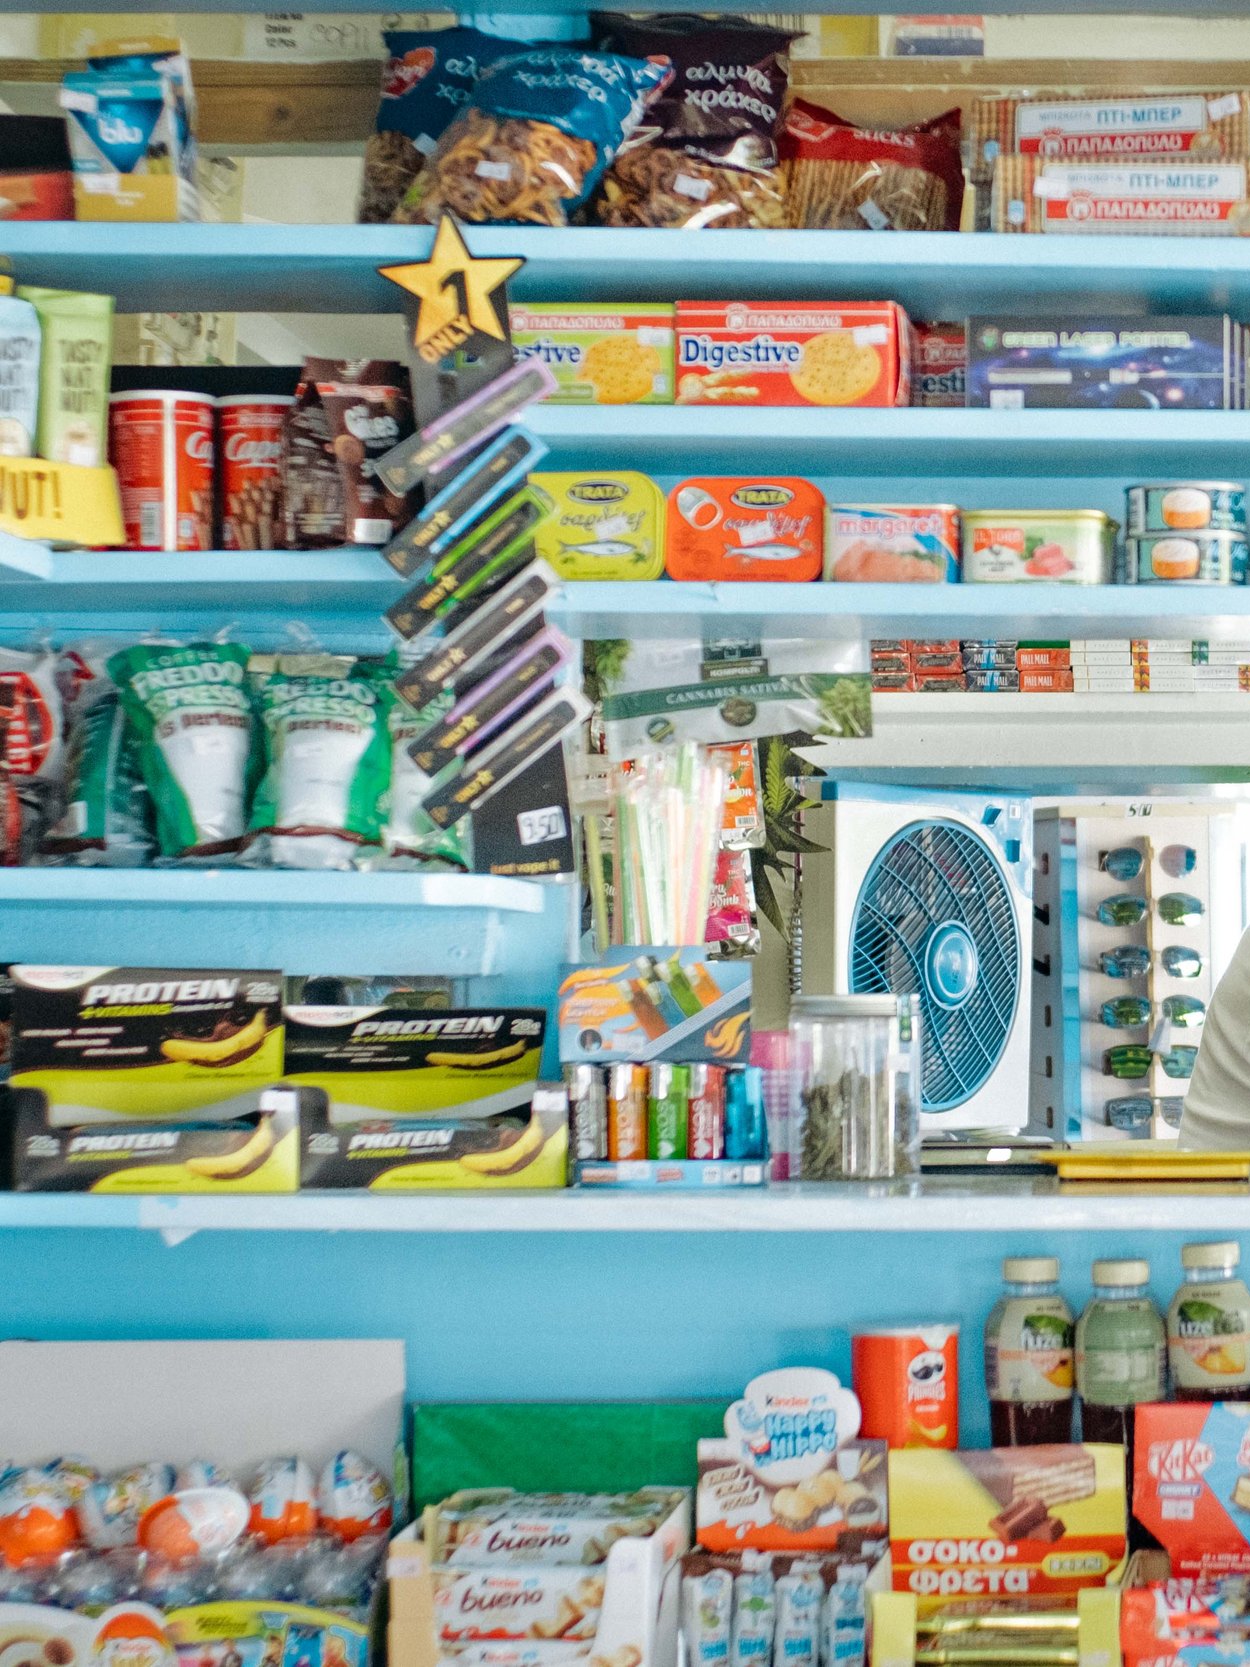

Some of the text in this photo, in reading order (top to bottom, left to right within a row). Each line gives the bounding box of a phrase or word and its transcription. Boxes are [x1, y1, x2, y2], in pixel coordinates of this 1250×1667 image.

[99, 116, 142, 145] blu
[419, 315, 474, 364] ONLY
[513, 345, 582, 364] estive
[681, 339, 801, 368] Digestive
[0, 467, 63, 520] UT!
[572, 484, 624, 502] TRATA
[738, 488, 788, 506] TRATA
[974, 654, 1005, 664] PALL MALL
[1021, 654, 1050, 665] PALL MALL
[129, 661, 244, 700] FREDDO
[977, 675, 1008, 686] PALL MALL
[1024, 675, 1053, 686] PALL MALL
[665, 680, 789, 705] CANNABIS SATIVA
[82, 977, 240, 1006] PROTEIN
[351, 1015, 504, 1036] PROTEIN
[68, 1131, 180, 1153] PROTEIN
[347, 1129, 455, 1151] PROTEIN
[1149, 1439, 1216, 1482] KitKat
[487, 1530, 573, 1552] bueno
[460, 1587, 544, 1614] bueno
